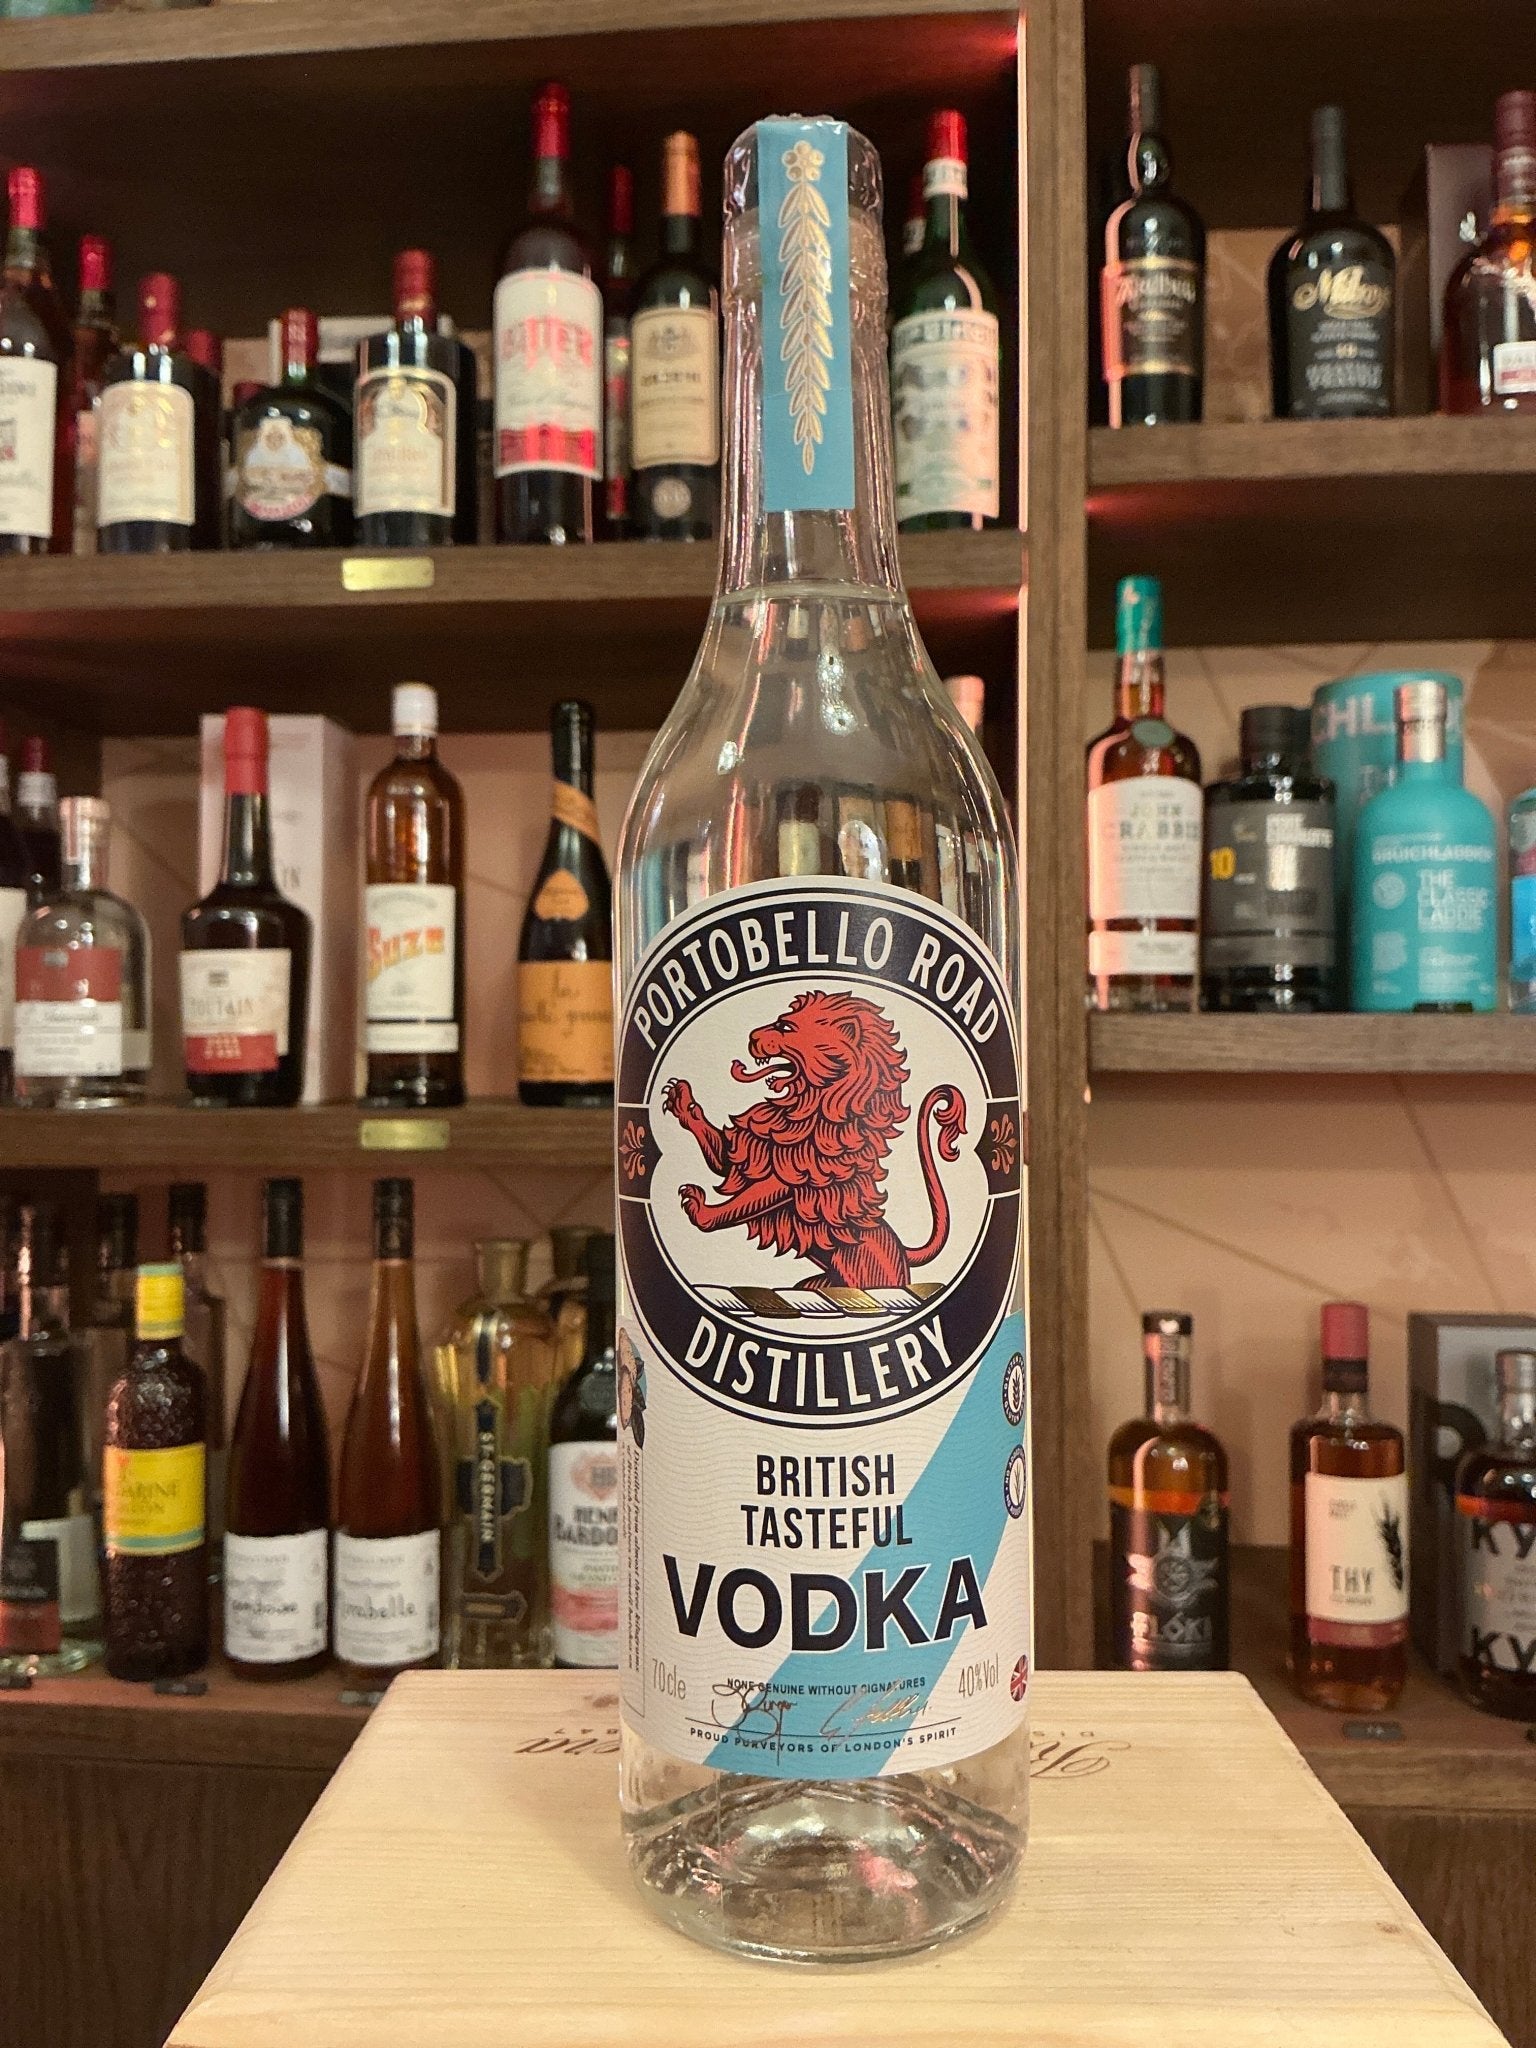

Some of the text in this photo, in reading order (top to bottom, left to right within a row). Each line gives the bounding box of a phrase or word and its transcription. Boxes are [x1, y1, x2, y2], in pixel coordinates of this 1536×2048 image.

[633, 910, 894, 1051] PORTOBELLO
[907, 932, 999, 1043] ROAD
[684, 1314, 952, 1408] DISTILLERY
[756, 1453, 895, 1498] BRITISH
[740, 1504, 913, 1550] TASTEFUL
[662, 1554, 988, 1652] VODKA
[652, 1657, 687, 1700] 70cle
[727, 1677, 756, 1691] NONE
[758, 1681, 805, 1695] GENUINE
[808, 1684, 858, 1696] WITHOUT
[690, 1727, 957, 1753] PROUD PURVEYORS OF LONDON'S SPIRIT
